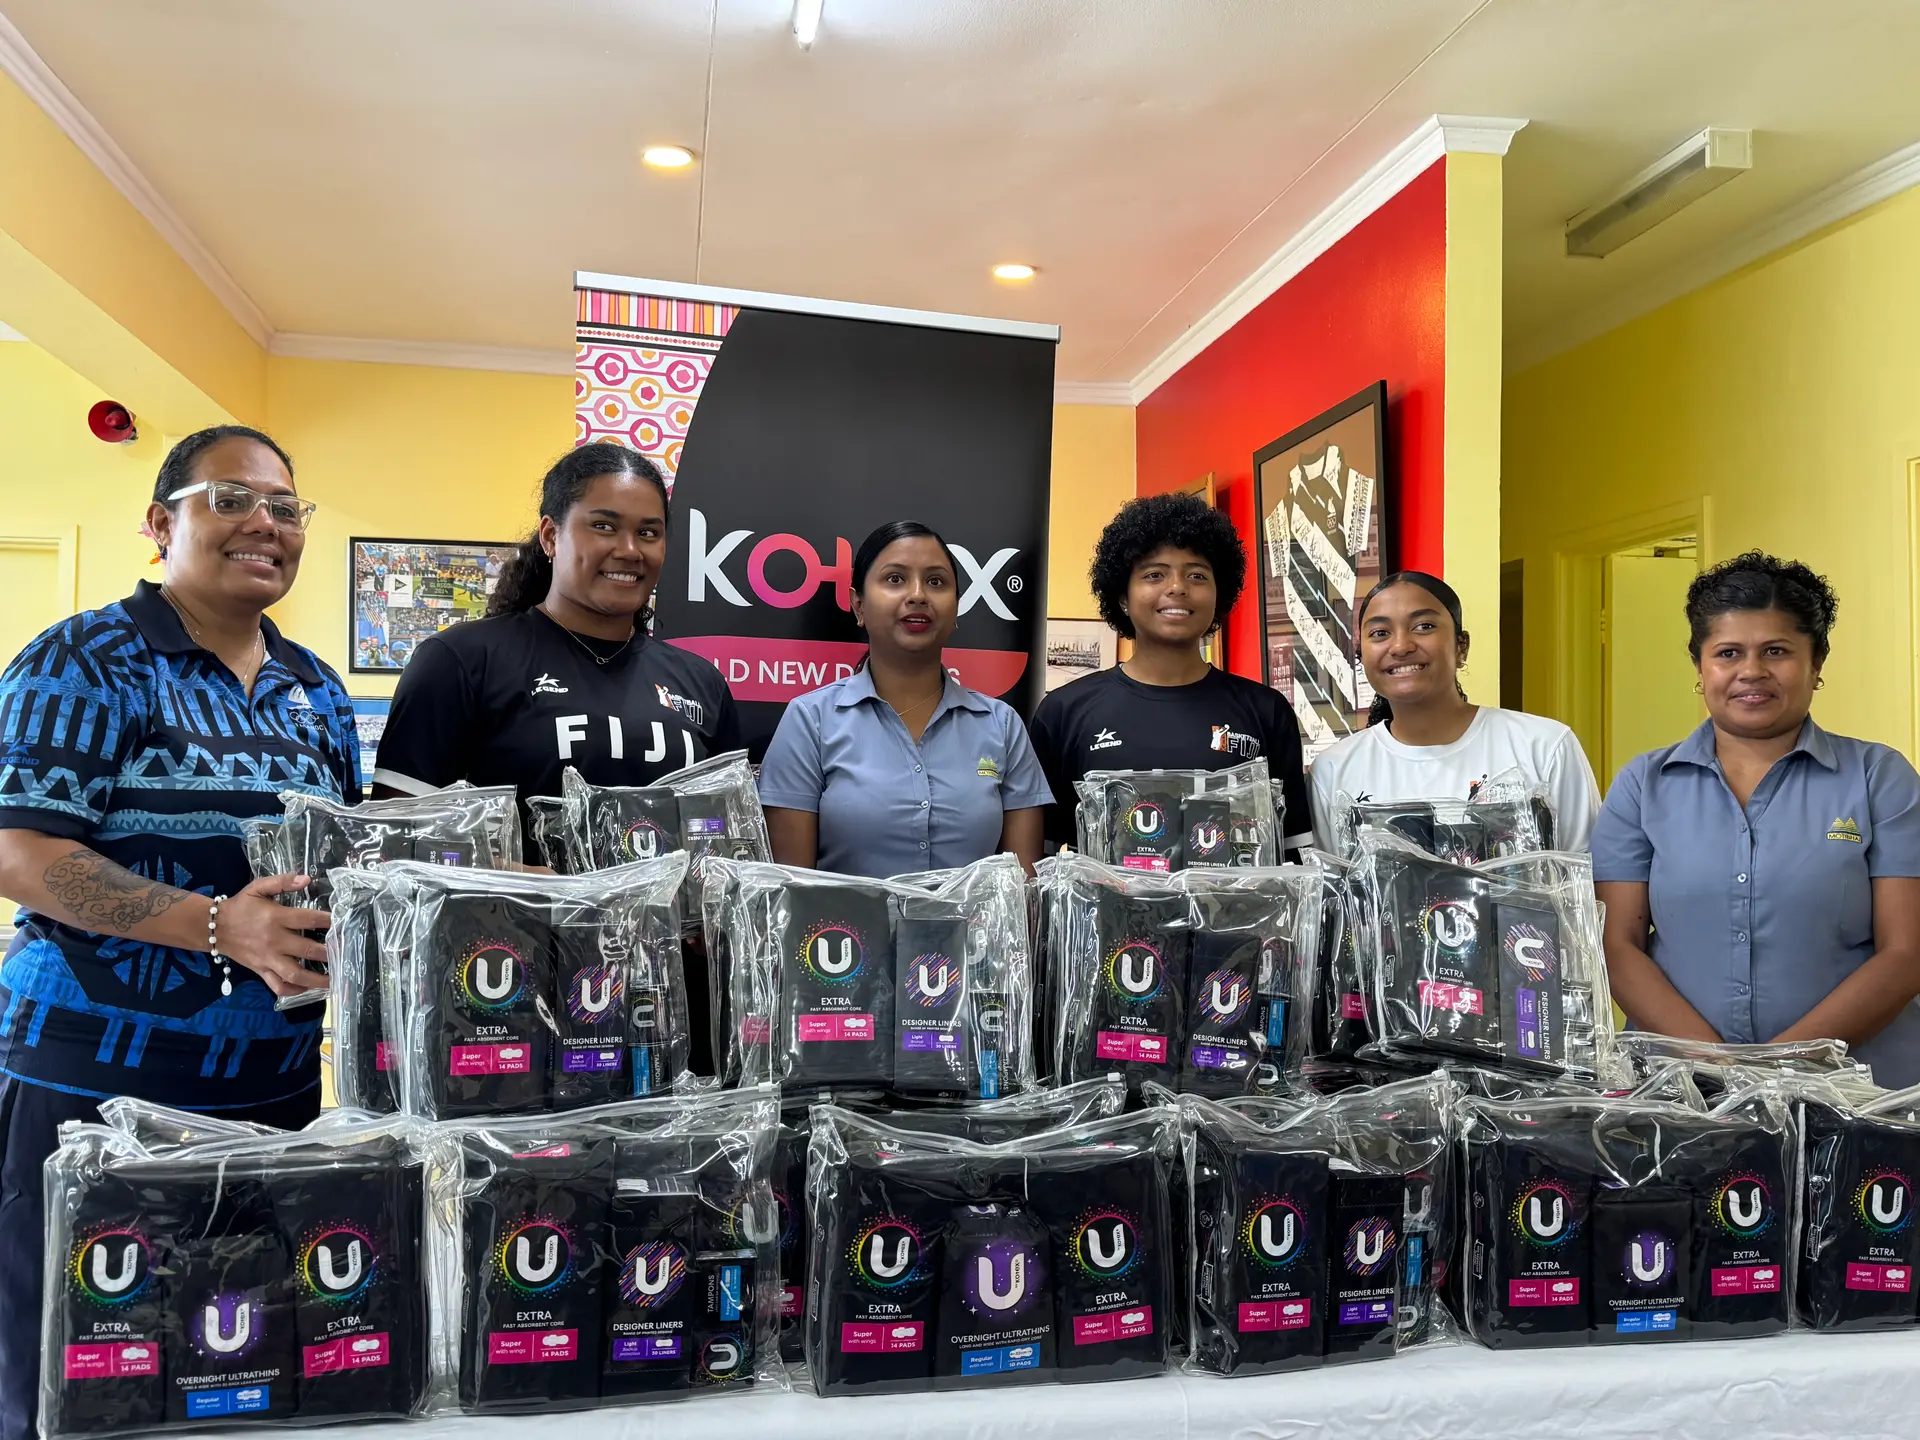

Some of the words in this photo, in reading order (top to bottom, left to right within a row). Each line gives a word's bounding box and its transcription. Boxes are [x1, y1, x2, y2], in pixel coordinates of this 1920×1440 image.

[759, 660, 827, 685] NEW
[531, 687, 569, 696] LEGEND
[555, 714, 695, 768] FIJI
[1090, 740, 1122, 751] LEGEND
[0, 757, 40, 765] EGEND
[1439, 967, 1464, 979] EXTRA
[821, 998, 851, 1006] EXTRA
[1541, 992, 1549, 1031] DESIGNER
[1120, 1016, 1148, 1026] EXTRA
[476, 1026, 508, 1035] EXTRA
[563, 1037, 598, 1045] DESIGNER
[600, 1036, 623, 1044] LINERS
[1193, 1034, 1225, 1044] DESIGNER
[1227, 1038, 1248, 1046] LINERS
[462, 1053, 481, 1061] Super
[1733, 1251, 1760, 1260] EXTRA
[1869, 1247, 1895, 1256] EXTRA
[1532, 1262, 1560, 1270] EXTRA
[1262, 1283, 1290, 1292] EXTRA
[707, 1274, 715, 1314] TAMPONS
[1096, 1292, 1127, 1304] EXTRA
[1339, 1290, 1370, 1298] DESIGNER
[1372, 1288, 1394, 1296] LINERS
[1609, 1299, 1646, 1307] OVERNIGHT
[1648, 1297, 1684, 1305] ULTRATHINS
[868, 1305, 901, 1313] EXTRA
[516, 1311, 552, 1321] EXTRA
[93, 1322, 131, 1333] EXTRA
[327, 1316, 361, 1332] EXTRA
[613, 1323, 654, 1331] DESIGNER
[655, 1321, 683, 1329] LINERS
[1084, 1321, 1103, 1329] Super
[951, 1332, 1001, 1344] OVERNIGHT
[1002, 1325, 1050, 1339] ULTRATHINS
[501, 1340, 521, 1348] Super
[77, 1353, 100, 1361] Super
[971, 1356, 993, 1364] Regular
[176, 1374, 227, 1385] OVERNIGHT
[228, 1369, 280, 1381] ULTRATHINS
